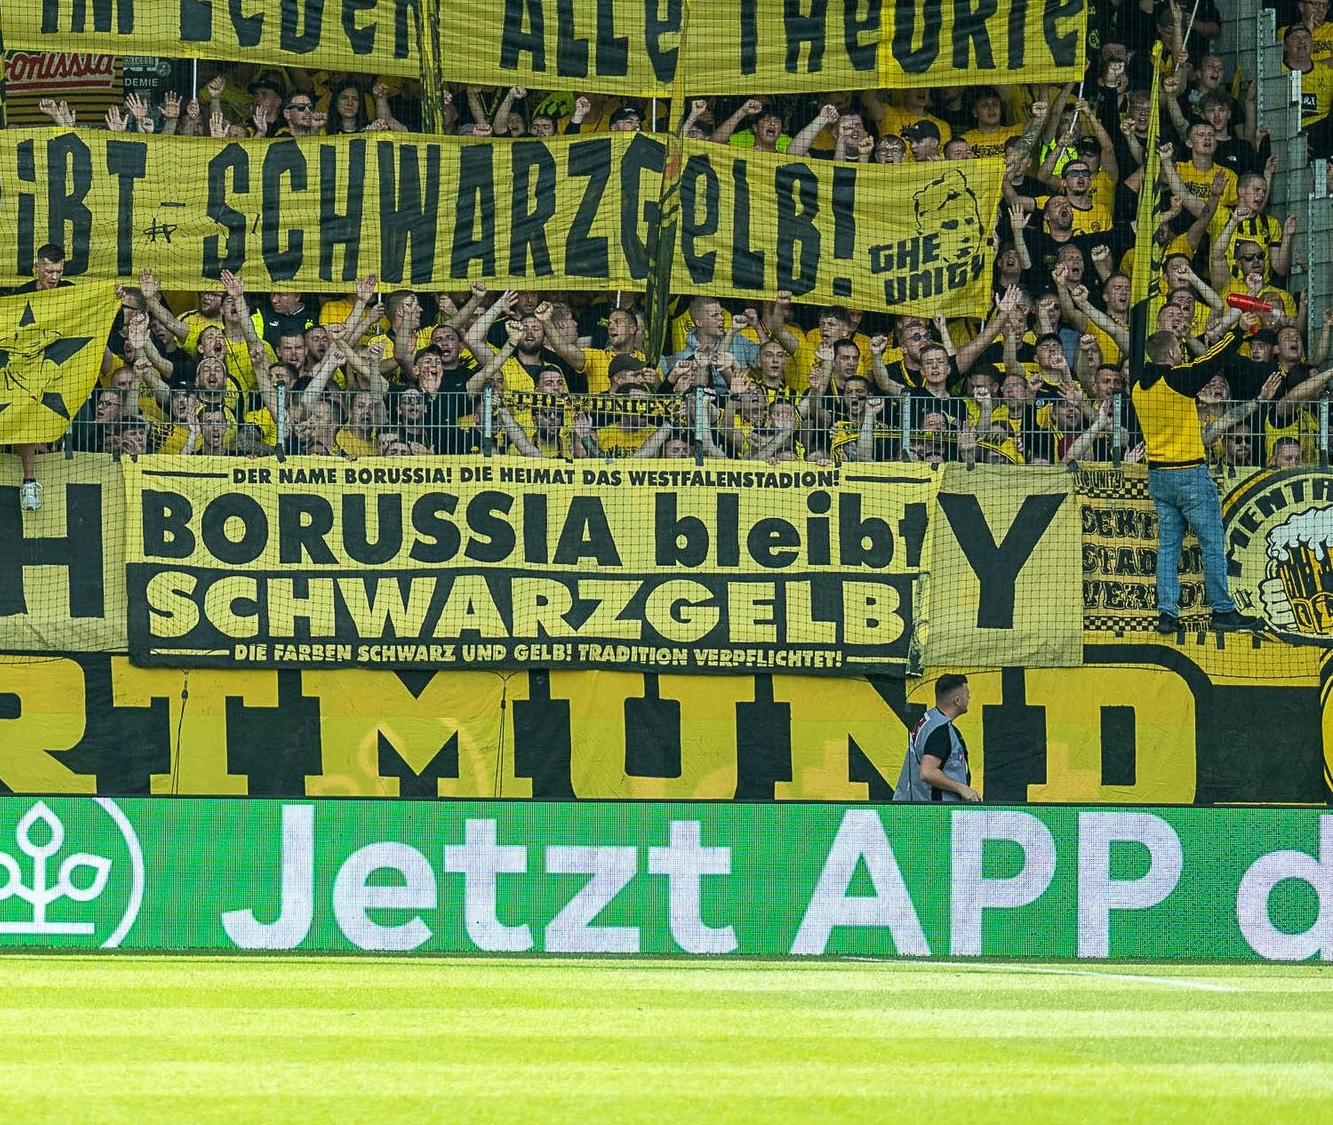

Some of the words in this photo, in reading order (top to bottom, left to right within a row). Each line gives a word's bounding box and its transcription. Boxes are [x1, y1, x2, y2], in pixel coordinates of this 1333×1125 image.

[234, 468, 271, 482] DER
[278, 468, 338, 483] NAME
[344, 468, 452, 483] BORUSSIA!
[459, 467, 492, 482] DIE
[500, 469, 576, 484] HEIMAT
[582, 470, 621, 485] DAS
[628, 470, 840, 487] WESTFALENSTADION!
[142, 490, 621, 568] BORUSSIA
[655, 492, 929, 569] bleibt
[144, 572, 909, 645] SCHWARZGELB
[234, 644, 269, 662] DIE
[273, 644, 349, 662] FARBEN
[358, 645, 455, 663] SCHWARZ
[460, 645, 506, 663] UND
[512, 645, 572, 663] GELB!
[578, 645, 688, 665] TRADITION
[223, 805, 738, 953] Jetzt
[789, 808, 1183, 958] APP
